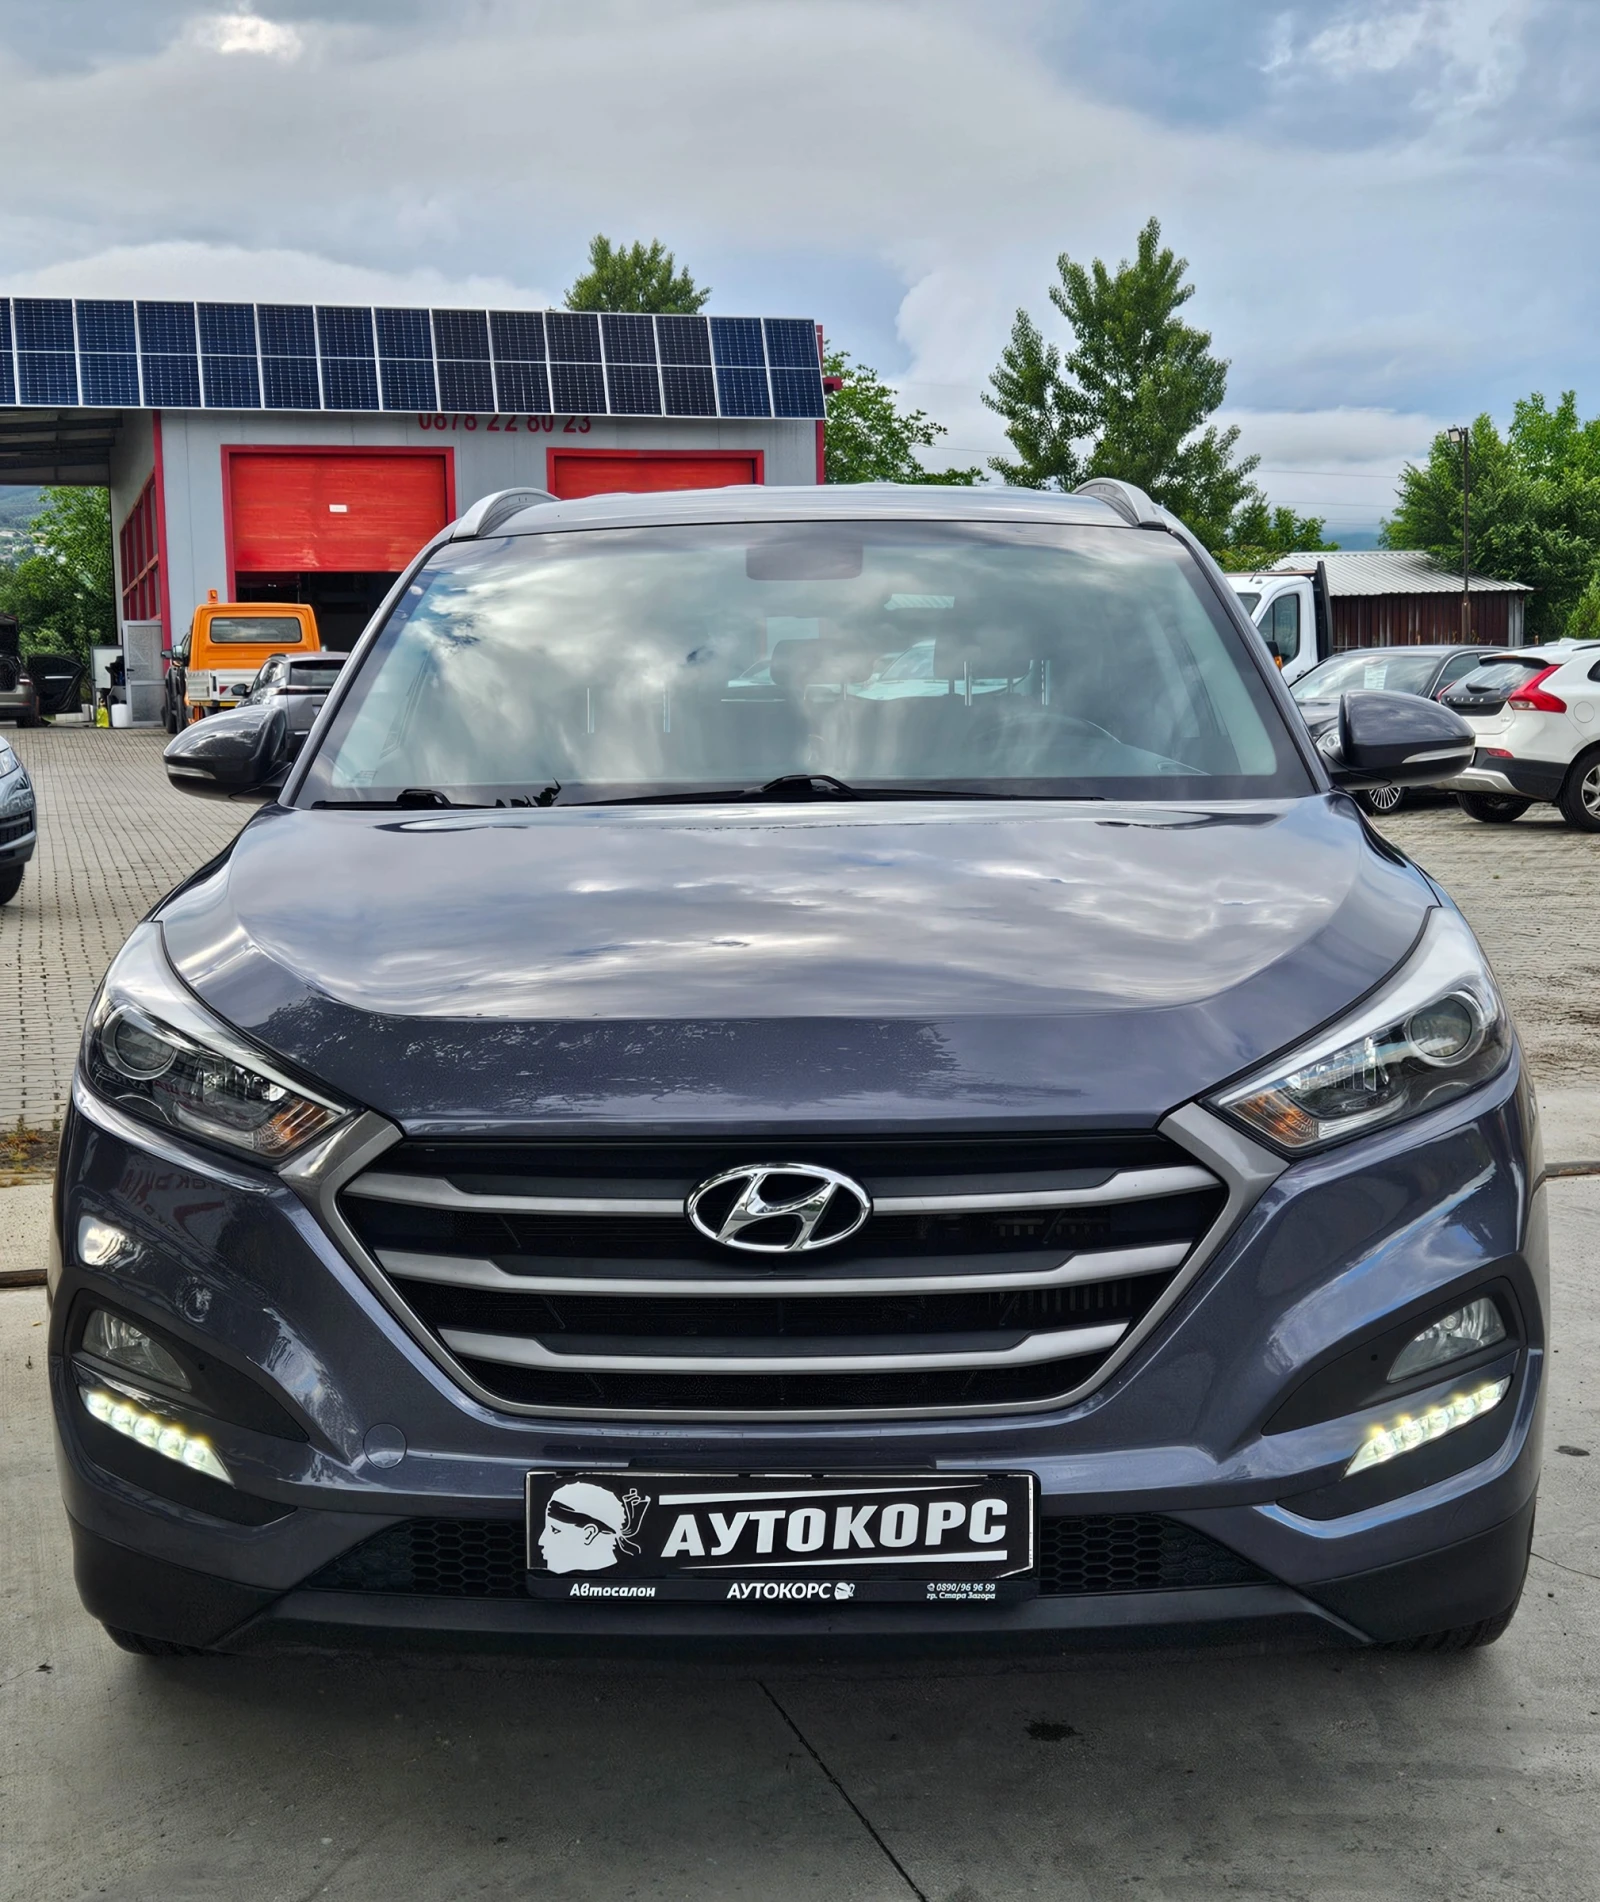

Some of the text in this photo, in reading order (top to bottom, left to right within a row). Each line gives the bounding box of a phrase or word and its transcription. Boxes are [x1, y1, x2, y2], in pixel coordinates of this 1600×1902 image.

[660, 1499, 1008, 1557] АУТОКОРС
[569, 1582, 656, 1598] Автосалон
[726, 1582, 832, 1600] АУТОКОРС
[973, 1583, 984, 1591] 96
[985, 1583, 995, 1591] 99
[939, 1592, 967, 1600] Стара
[967, 1592, 996, 1600] Загора
